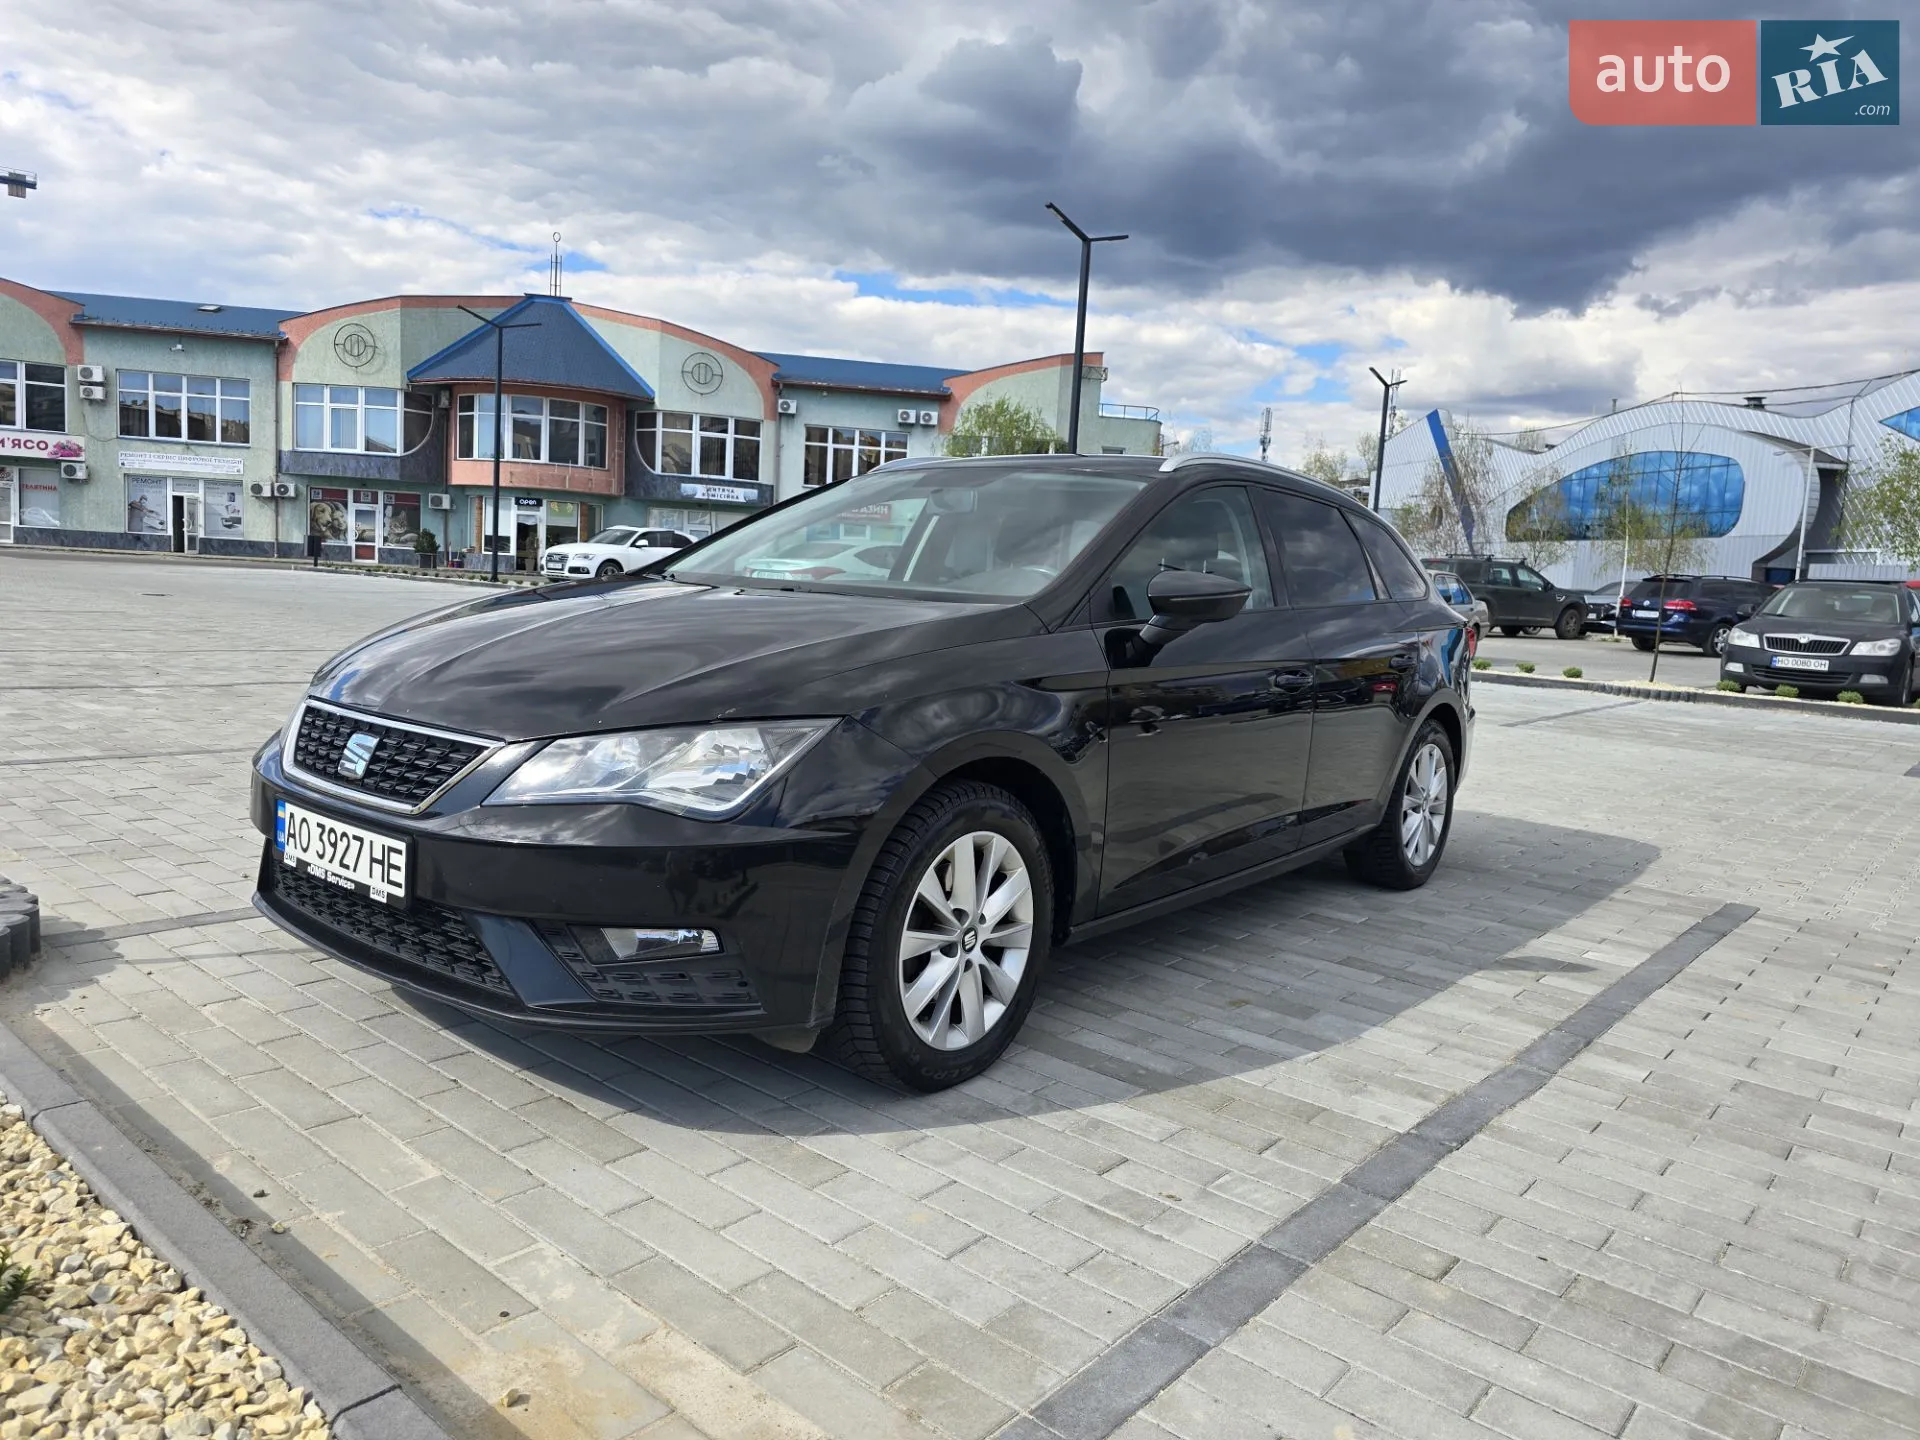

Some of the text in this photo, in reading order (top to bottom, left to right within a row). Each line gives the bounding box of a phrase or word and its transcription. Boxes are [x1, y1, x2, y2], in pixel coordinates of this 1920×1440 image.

[22, 483, 58, 492] ТЕЛЯТИНА
[132, 477, 162, 485] РЕМОНТ
[277, 830, 285, 844] UA
[286, 811, 403, 889] AO 3927 HE
[371, 886, 386, 899] DMS
